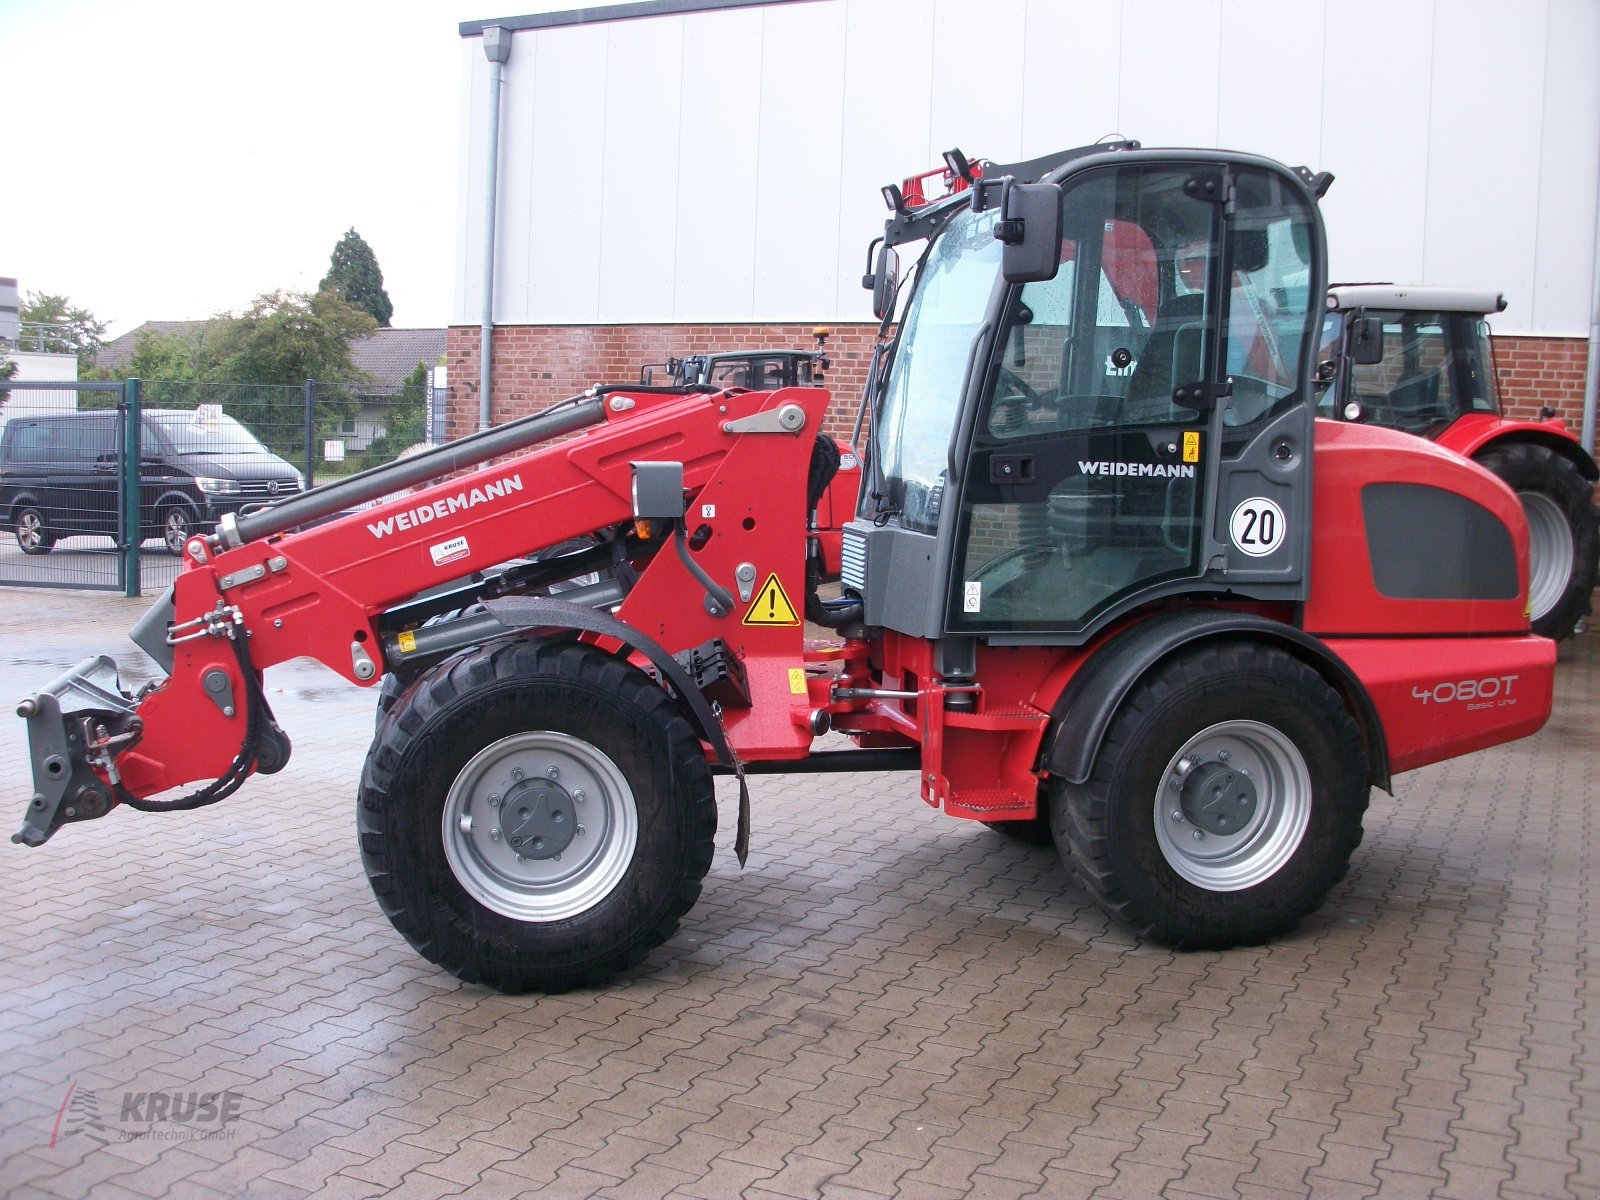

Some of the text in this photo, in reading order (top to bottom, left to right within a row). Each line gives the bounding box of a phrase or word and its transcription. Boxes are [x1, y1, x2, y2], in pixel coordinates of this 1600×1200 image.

[1077, 461, 1195, 478] WEIDEMANN
[366, 474, 523, 539] WEIDEMANN
[1240, 508, 1275, 545] 20
[444, 540, 465, 551] KRUSE
[1411, 675, 1519, 705] 4080T
[1467, 698, 1517, 711] Basic Line
